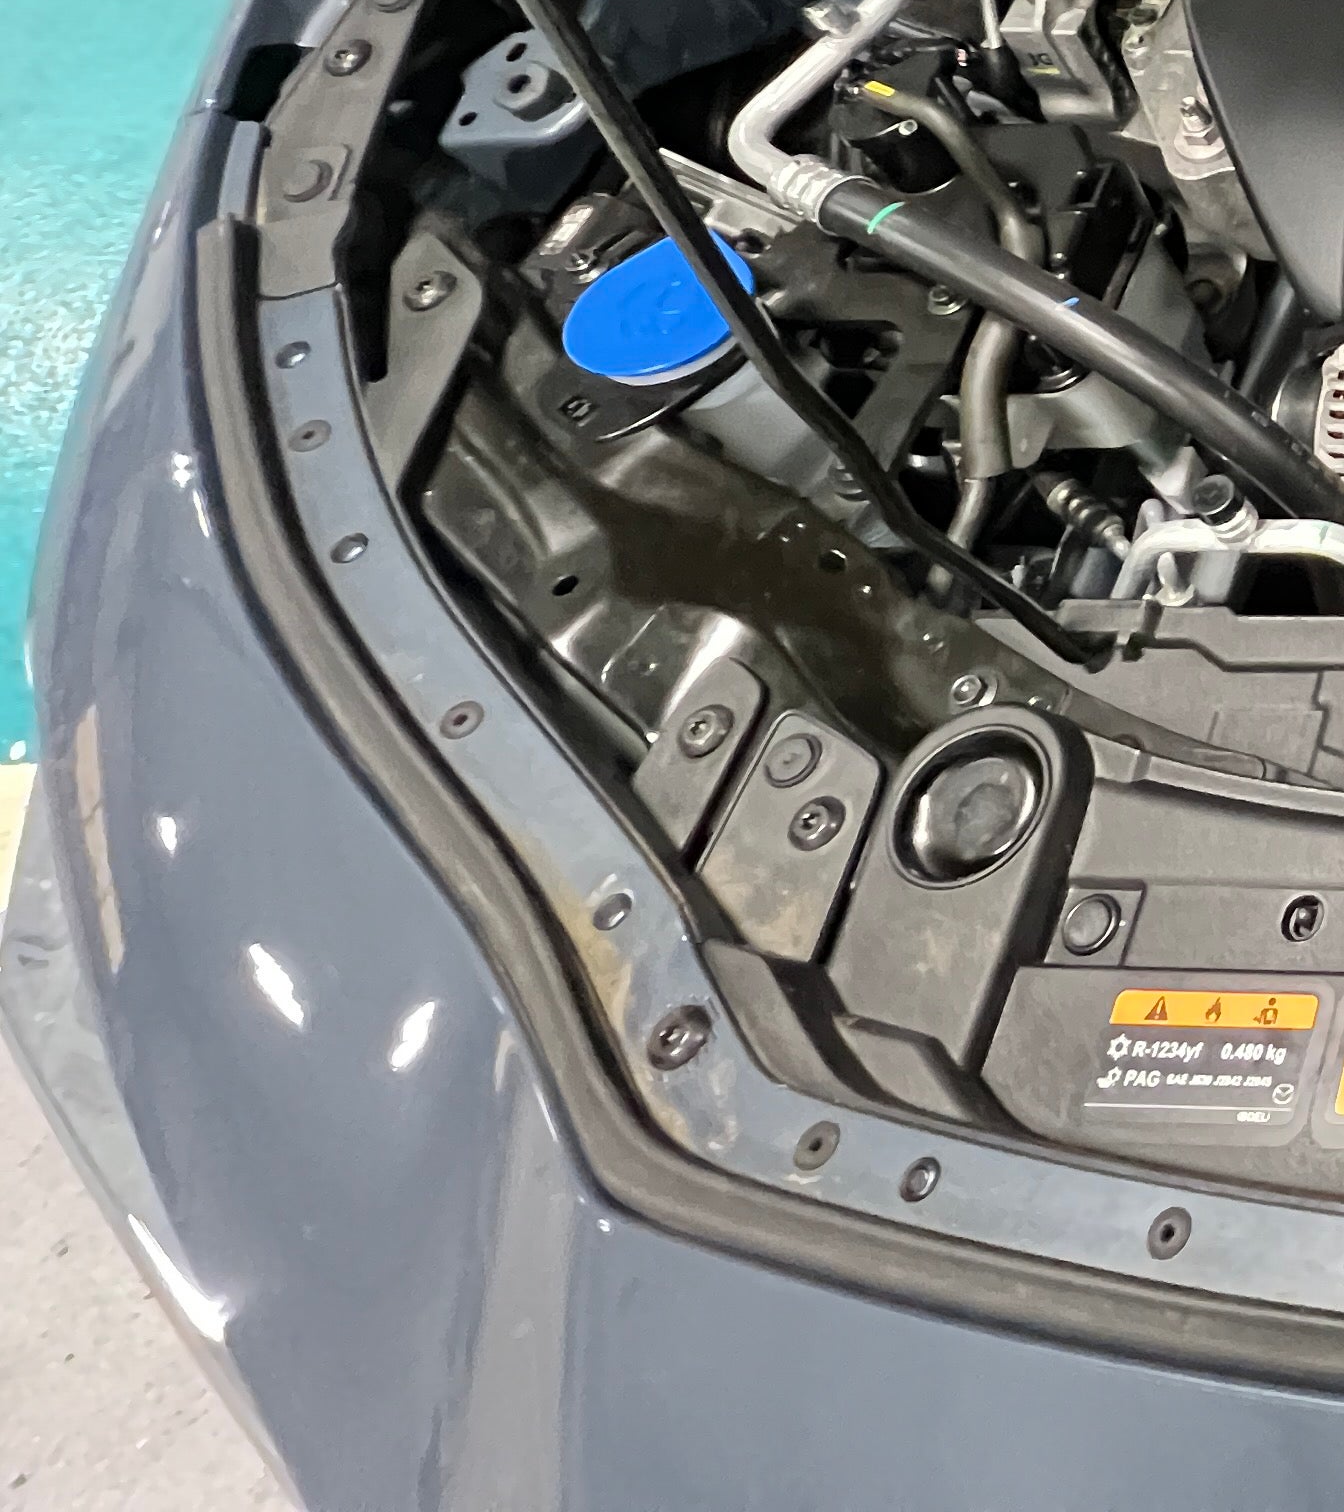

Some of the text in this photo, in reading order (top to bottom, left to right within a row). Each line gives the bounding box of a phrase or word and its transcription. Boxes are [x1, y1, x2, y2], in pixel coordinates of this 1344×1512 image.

[1131, 1040, 1288, 1065] R-1234yf 0.480 kg
[1123, 1069, 1161, 1087] PAG
